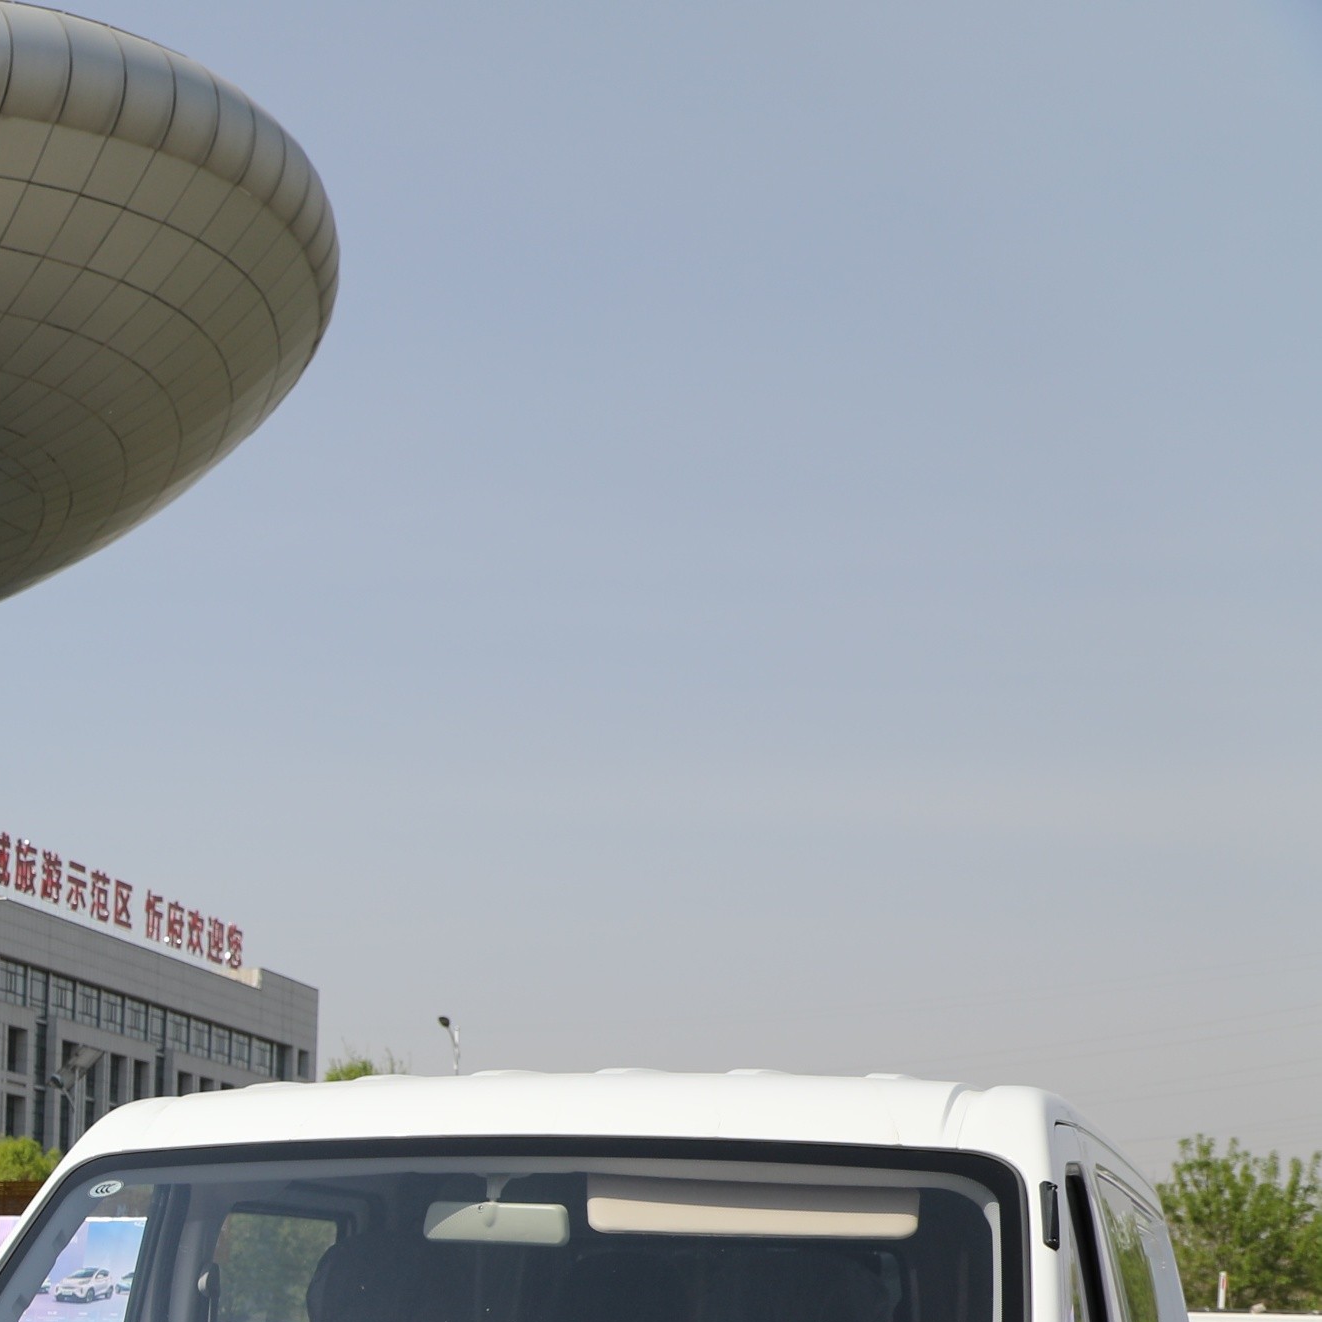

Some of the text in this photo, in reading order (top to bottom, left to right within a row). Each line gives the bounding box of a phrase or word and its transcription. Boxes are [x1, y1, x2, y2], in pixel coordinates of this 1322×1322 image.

[145, 888, 244, 970] 忻府欢迎您
